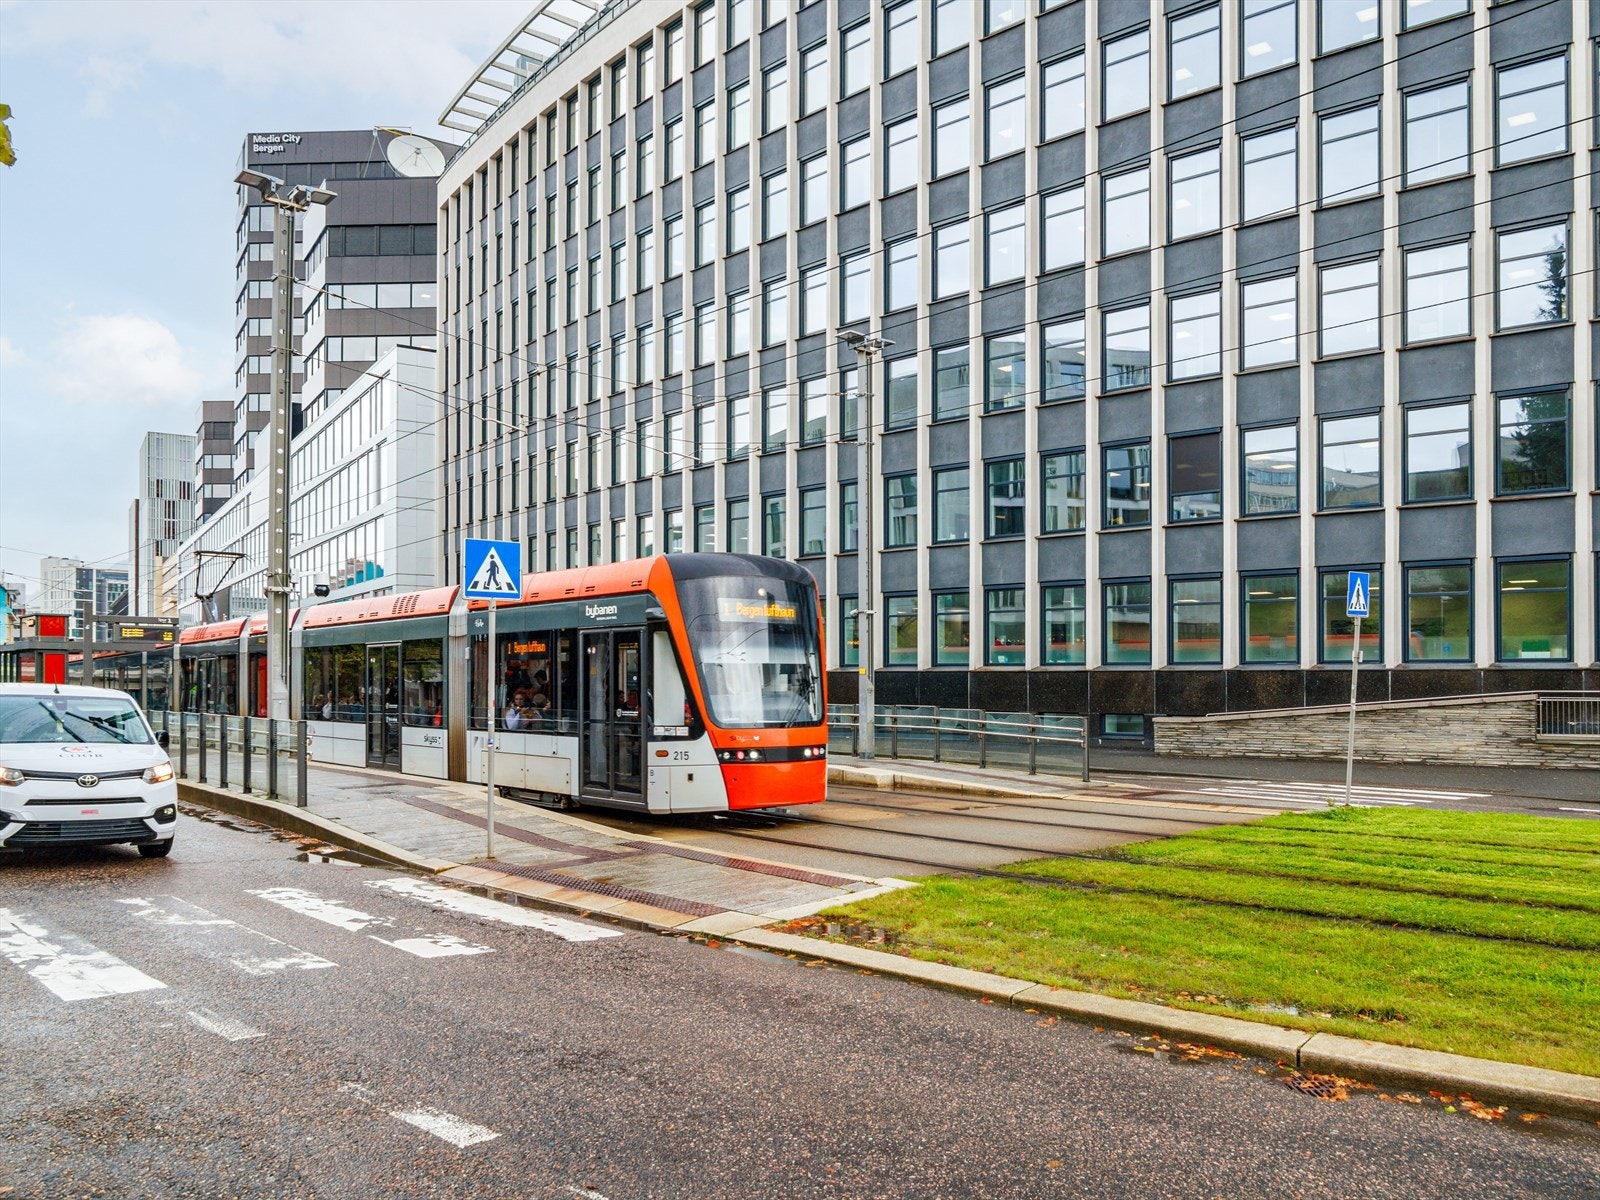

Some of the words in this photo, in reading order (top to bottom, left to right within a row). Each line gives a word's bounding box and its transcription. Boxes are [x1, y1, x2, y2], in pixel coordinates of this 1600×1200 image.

[253, 135, 280, 143] Media
[282, 134, 301, 143] City
[253, 144, 283, 153] Bergen
[585, 604, 617, 618] bybanen
[736, 602, 763, 618] Bergen
[507, 643, 512, 655] 1
[514, 641, 528, 655] Bergen
[673, 751, 690, 761] 215
